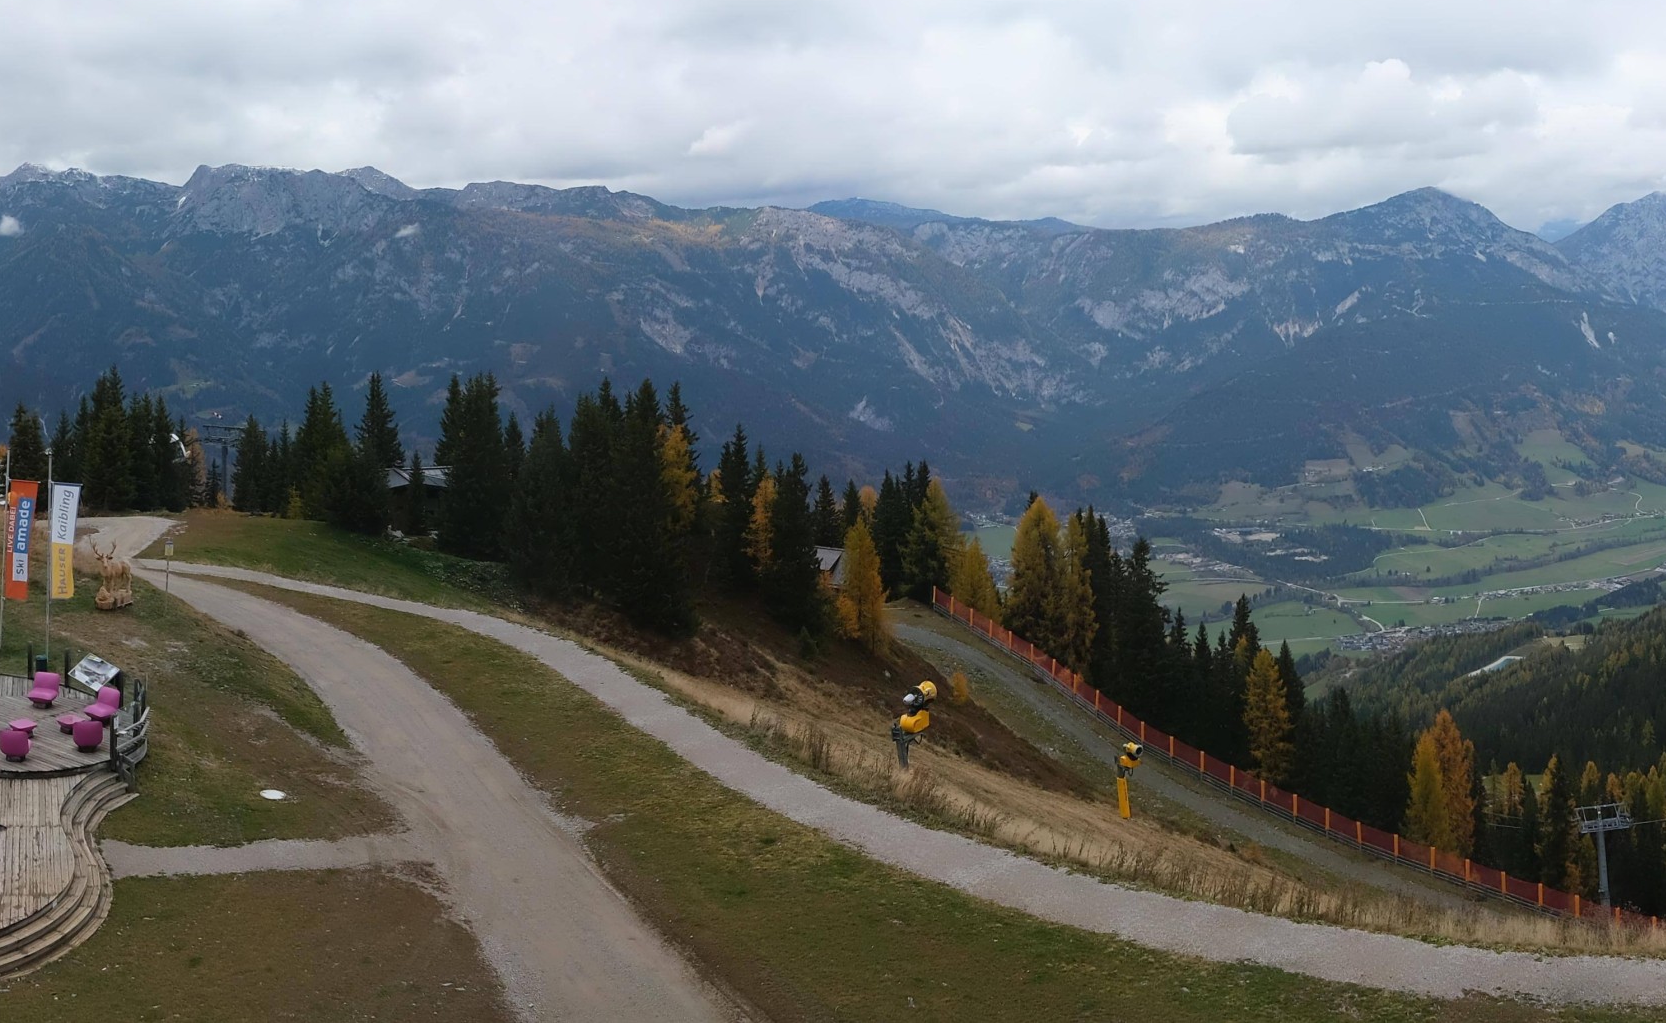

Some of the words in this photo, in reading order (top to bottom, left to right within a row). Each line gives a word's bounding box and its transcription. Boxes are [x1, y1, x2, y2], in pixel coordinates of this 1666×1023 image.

[9, 506, 17, 531] DABEI
[17, 500, 31, 551] amade
[57, 489, 74, 540] Kaibling
[7, 531, 15, 553] LIVE
[16, 559, 24, 575] Ski
[57, 547, 68, 595] HAUSER
